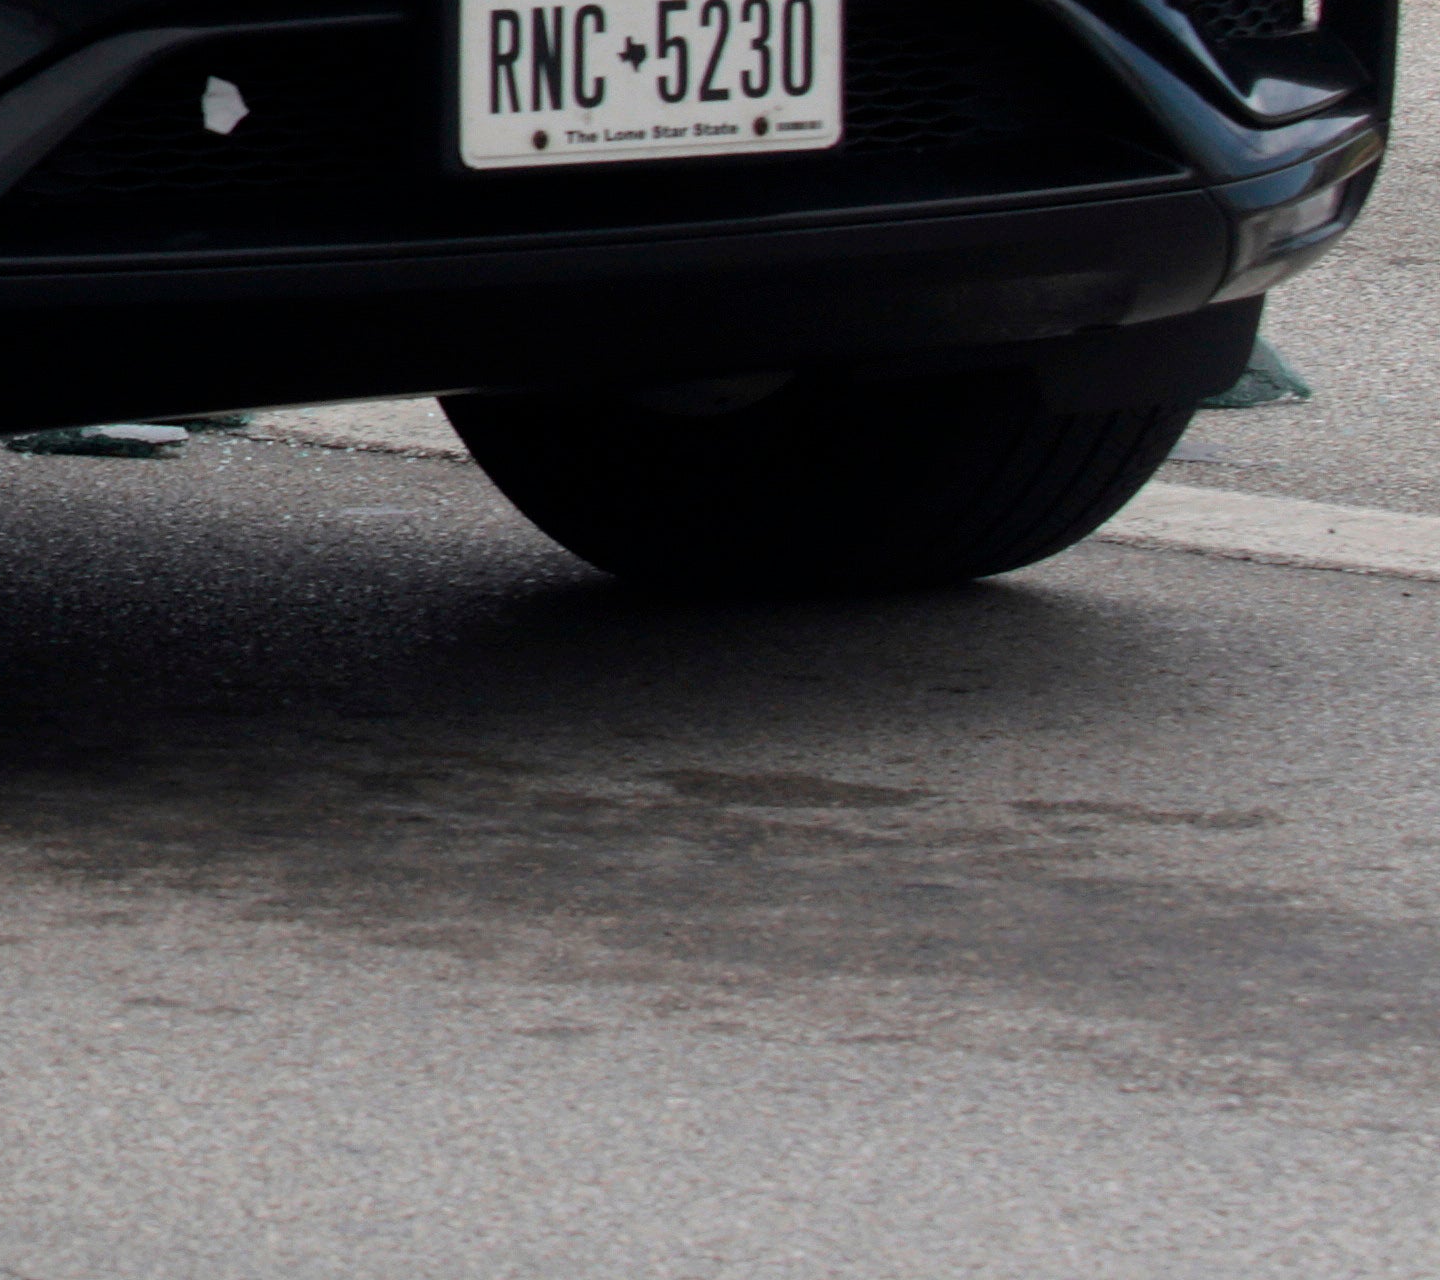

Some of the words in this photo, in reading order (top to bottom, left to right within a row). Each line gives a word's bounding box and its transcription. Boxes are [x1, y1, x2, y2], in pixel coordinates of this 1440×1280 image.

[566, 129, 598, 145] The
[604, 125, 646, 143] Lone
[652, 123, 687, 140] Star
[692, 120, 739, 138] State
